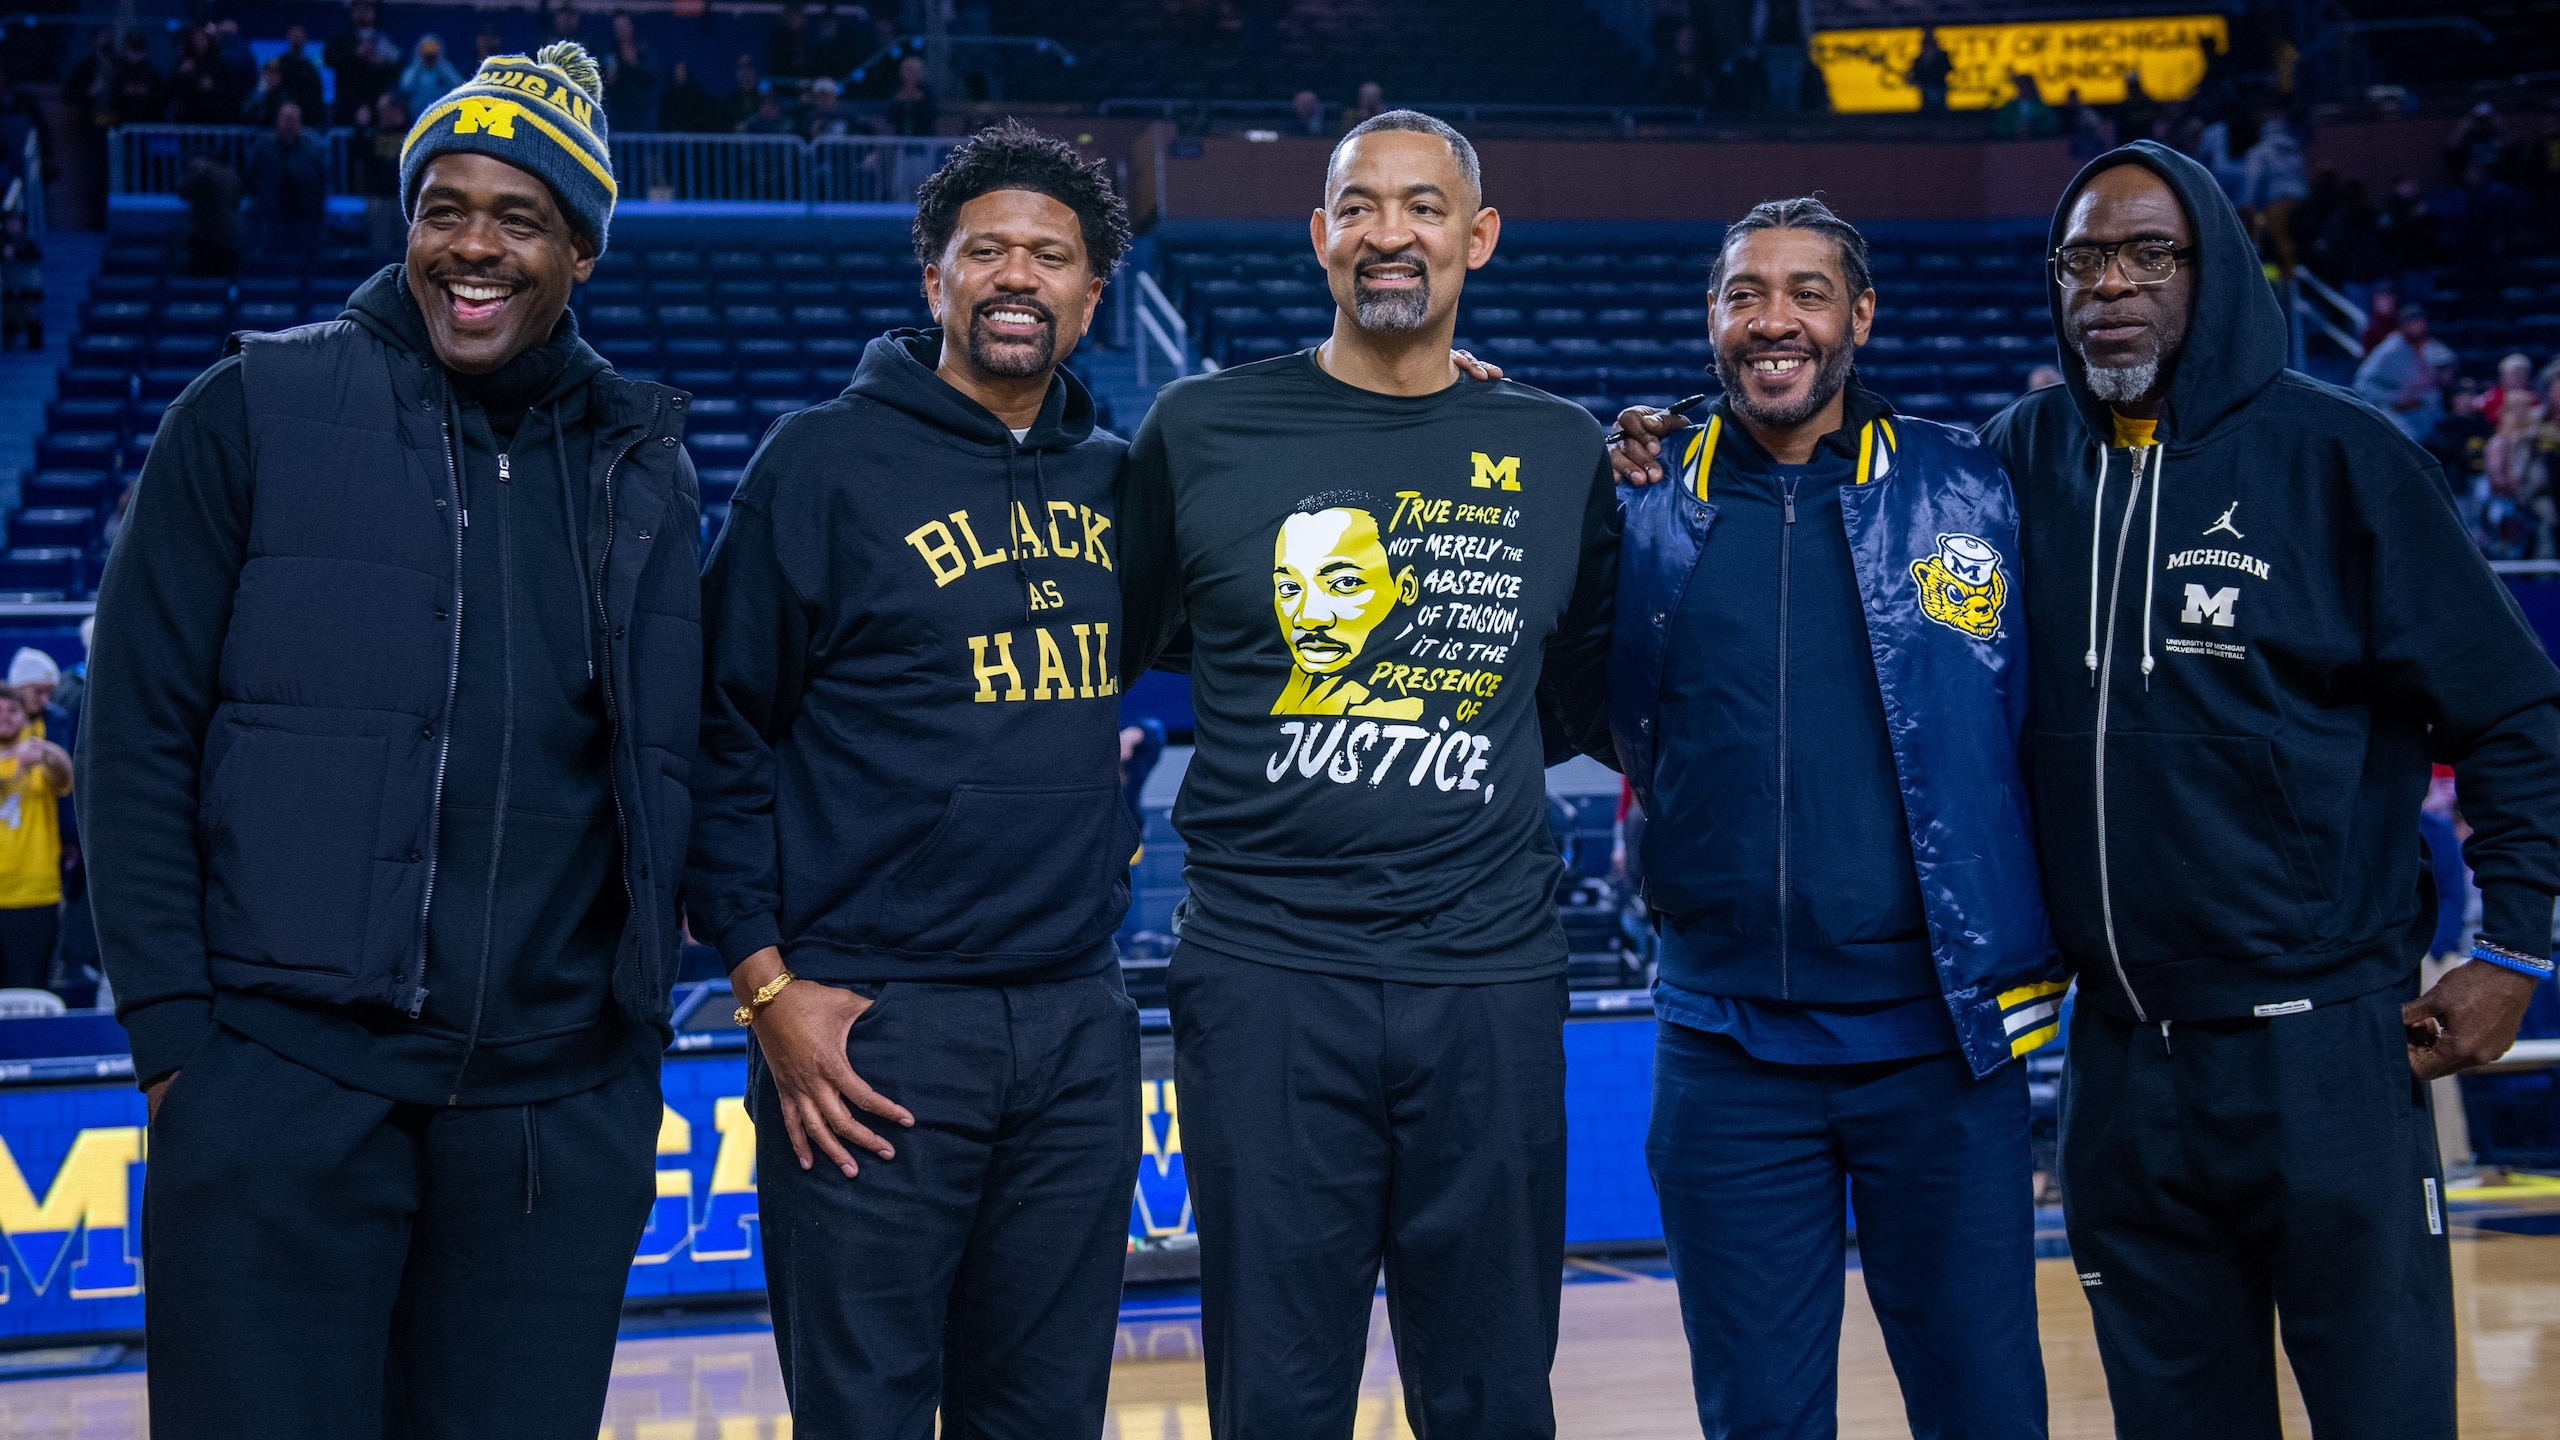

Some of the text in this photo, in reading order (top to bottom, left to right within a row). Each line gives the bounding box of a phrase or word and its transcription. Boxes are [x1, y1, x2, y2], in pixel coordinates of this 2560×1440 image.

[454, 101, 519, 139] M
[1470, 451, 1521, 491] M
[1388, 490, 1453, 533] TRUE
[1455, 504, 1501, 525] PEACE
[904, 500, 1113, 588] BLACK
[1388, 533, 1524, 567] NOT MERELY THE
[1951, 555, 1980, 582] M
[2166, 549, 2271, 581] MICHIGAN
[1029, 579, 1064, 611] AS
[1423, 568, 1523, 599] ABSENCE
[1417, 605, 1443, 626] OF
[2181, 583, 2240, 627] M
[1467, 643, 1509, 664] THE
[2165, 638, 2204, 647] UNIVERSITY
[2213, 642, 2246, 652] MICHIGAN
[2165, 645, 2245, 660] WOLVERINE BASKETBALL
[967, 622, 1114, 703] HAIL
[1368, 661, 1502, 697] PRESENCE
[1456, 698, 1483, 722] OF
